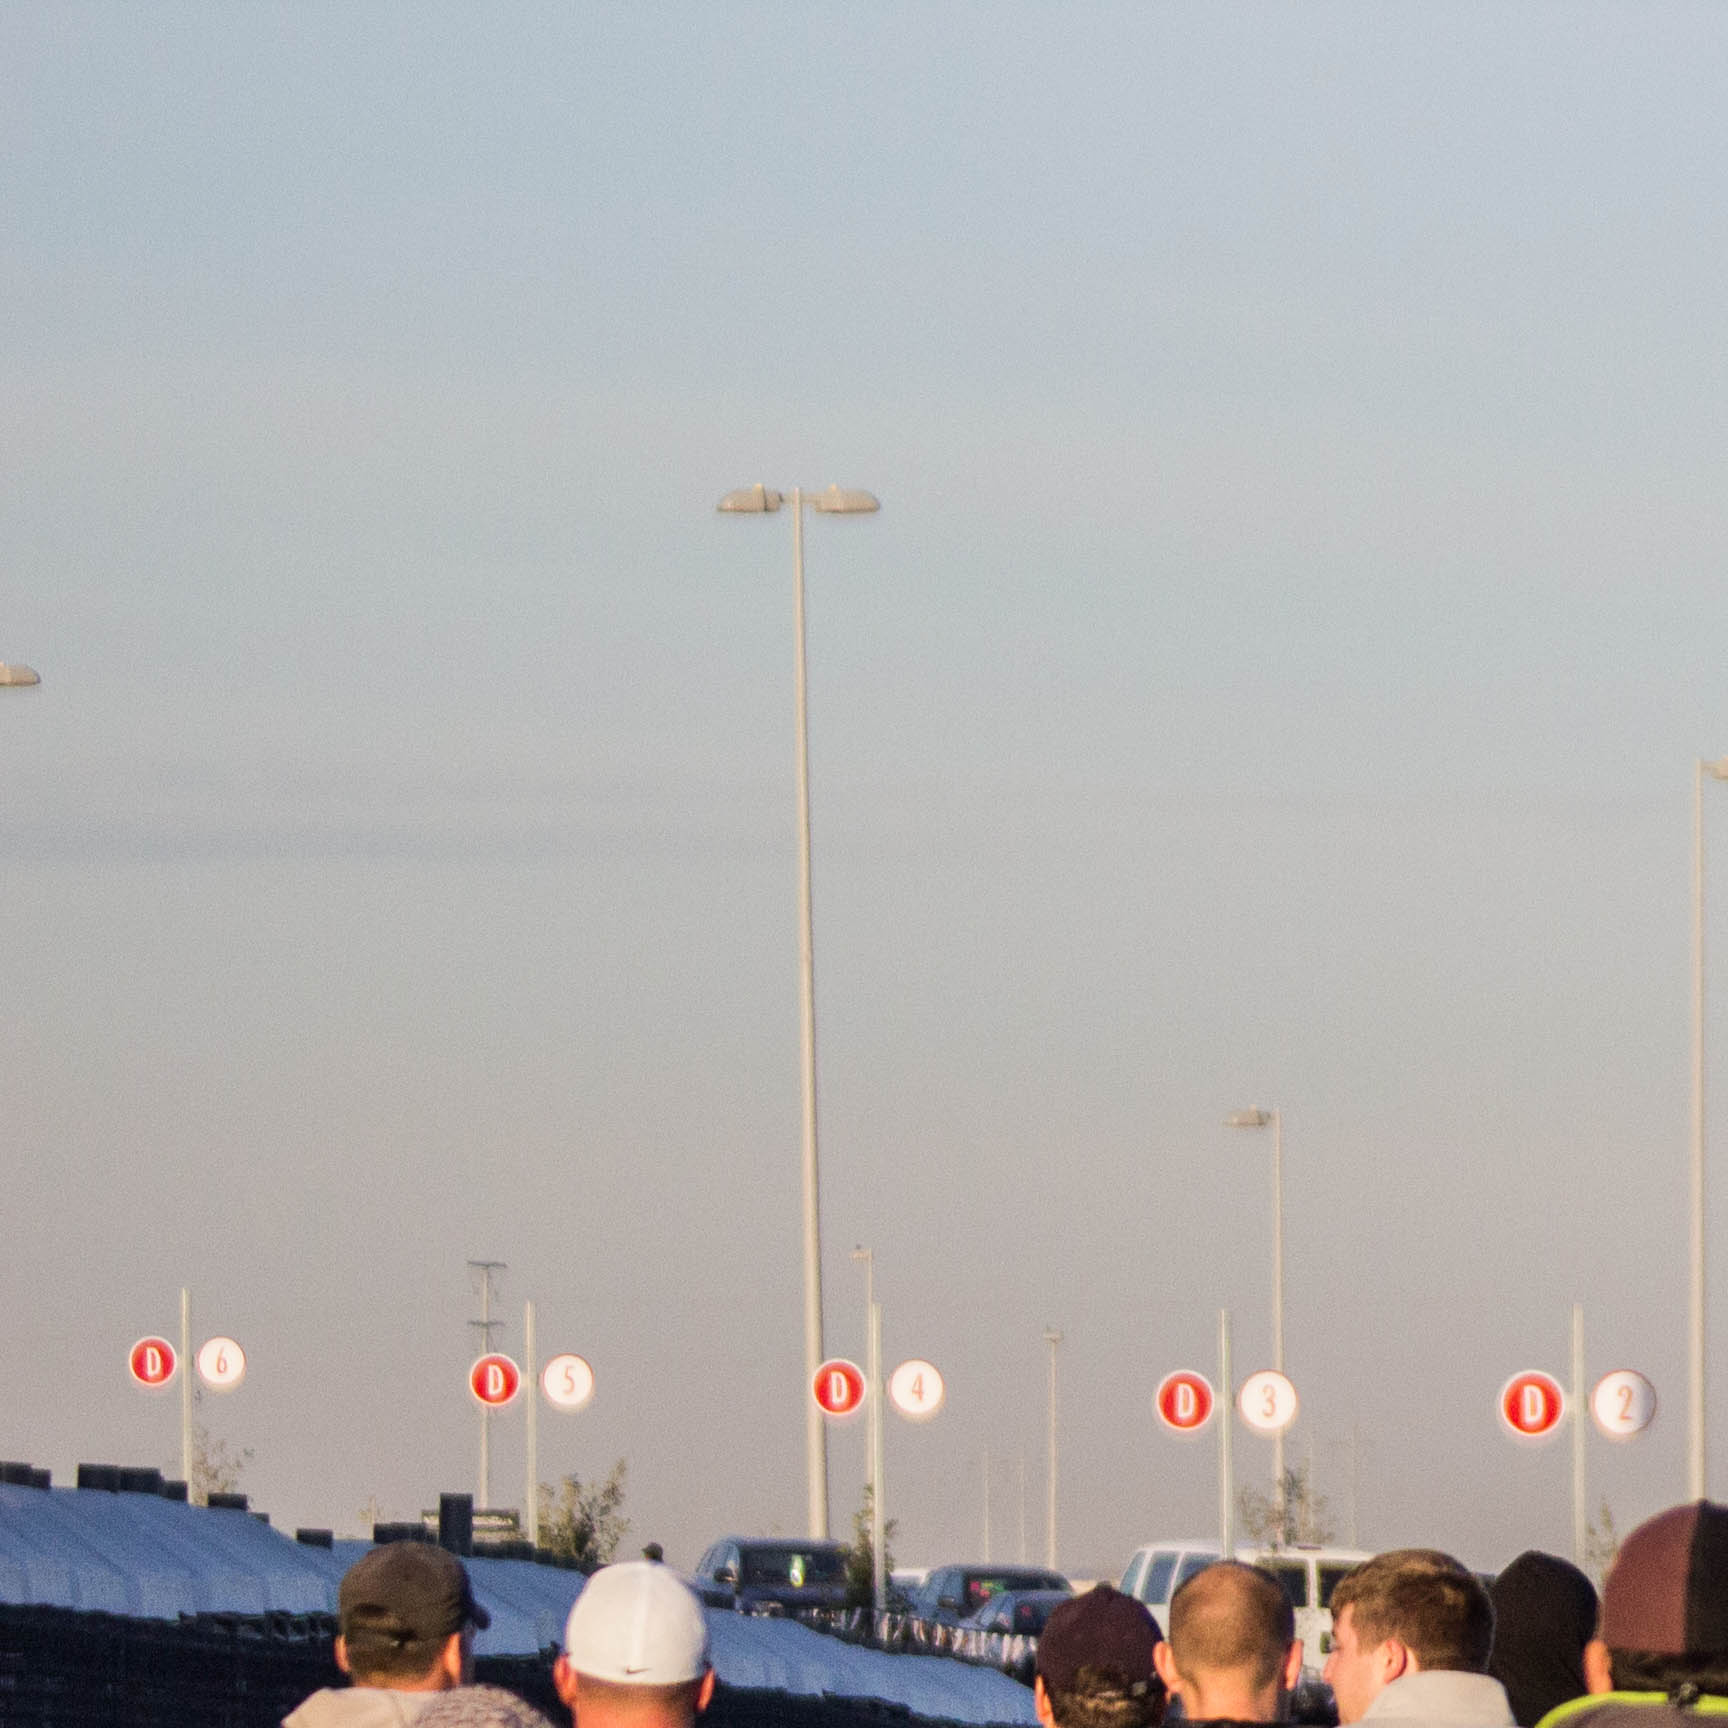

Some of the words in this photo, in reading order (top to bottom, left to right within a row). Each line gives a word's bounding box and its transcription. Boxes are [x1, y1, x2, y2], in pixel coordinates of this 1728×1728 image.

[145, 1346, 162, 1376] D
[216, 1345, 228, 1374] 6
[487, 1364, 505, 1396] D
[563, 1365, 576, 1395] 5
[830, 1371, 849, 1404] D
[911, 1373, 924, 1403] 4
[1176, 1383, 1196, 1418] D
[1262, 1384, 1276, 1417] 3
[1523, 1384, 1545, 1424] D
[1617, 1385, 1633, 1420] 2
